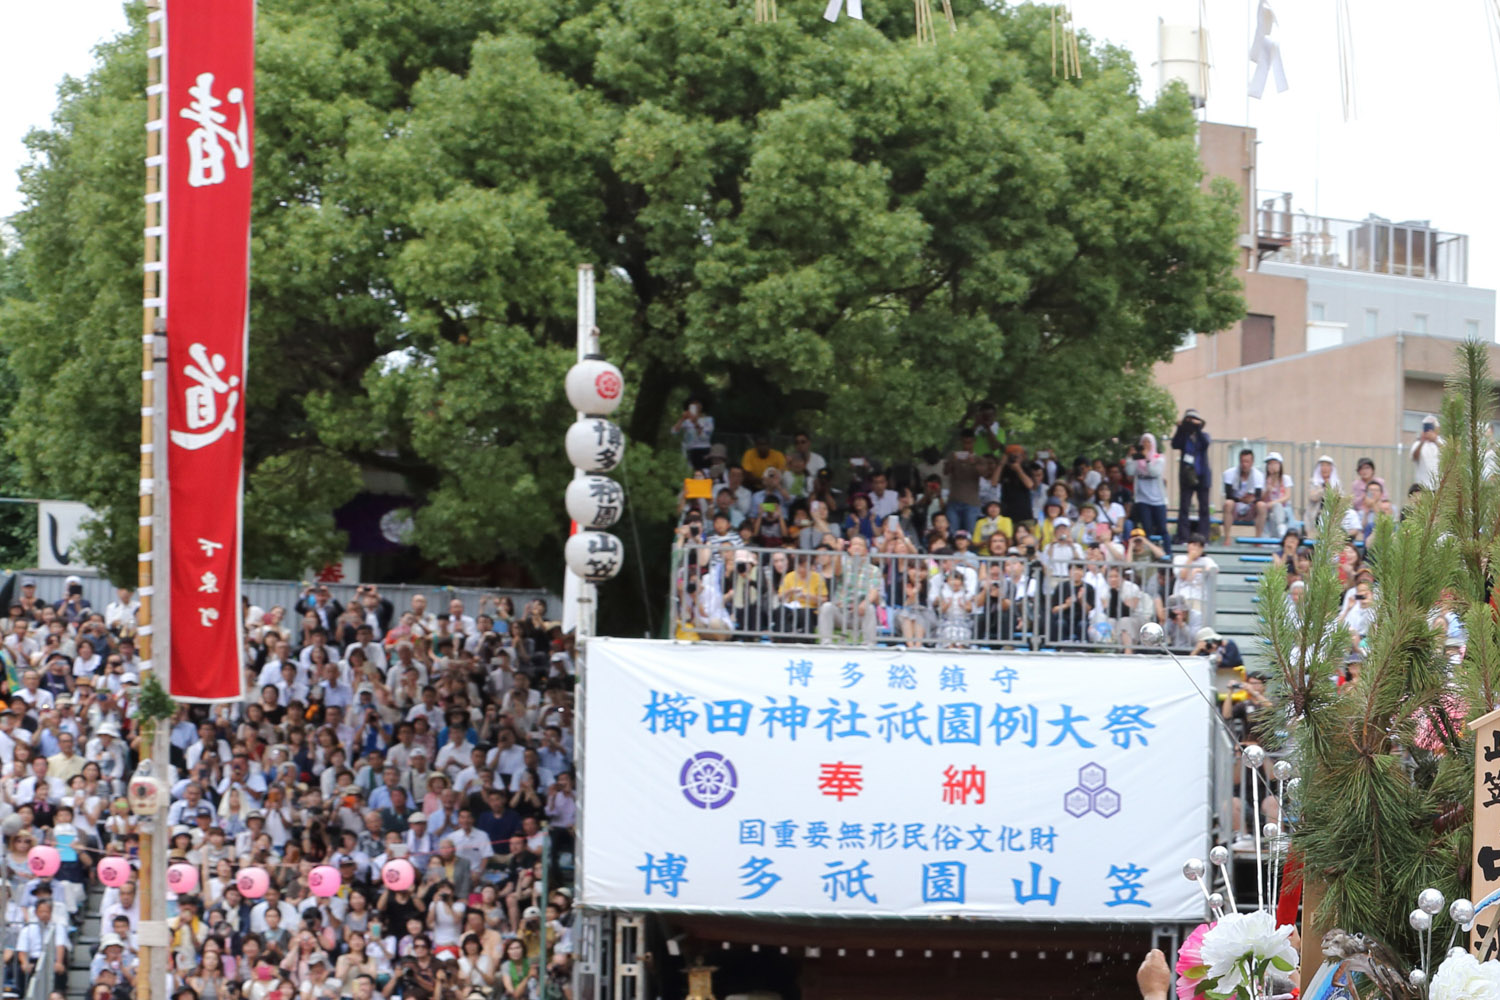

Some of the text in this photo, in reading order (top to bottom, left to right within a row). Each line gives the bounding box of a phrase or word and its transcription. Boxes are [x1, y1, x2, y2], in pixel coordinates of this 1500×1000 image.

[784, 659, 1020, 694] 博多総鎮守
[641, 689, 1157, 750] 櫛田神社祇園例大祭
[818, 761, 987, 805] 奉納
[738, 818, 1059, 854] 国重要無形民俗文化財
[636, 851, 1153, 909] 博多祇園山笠
